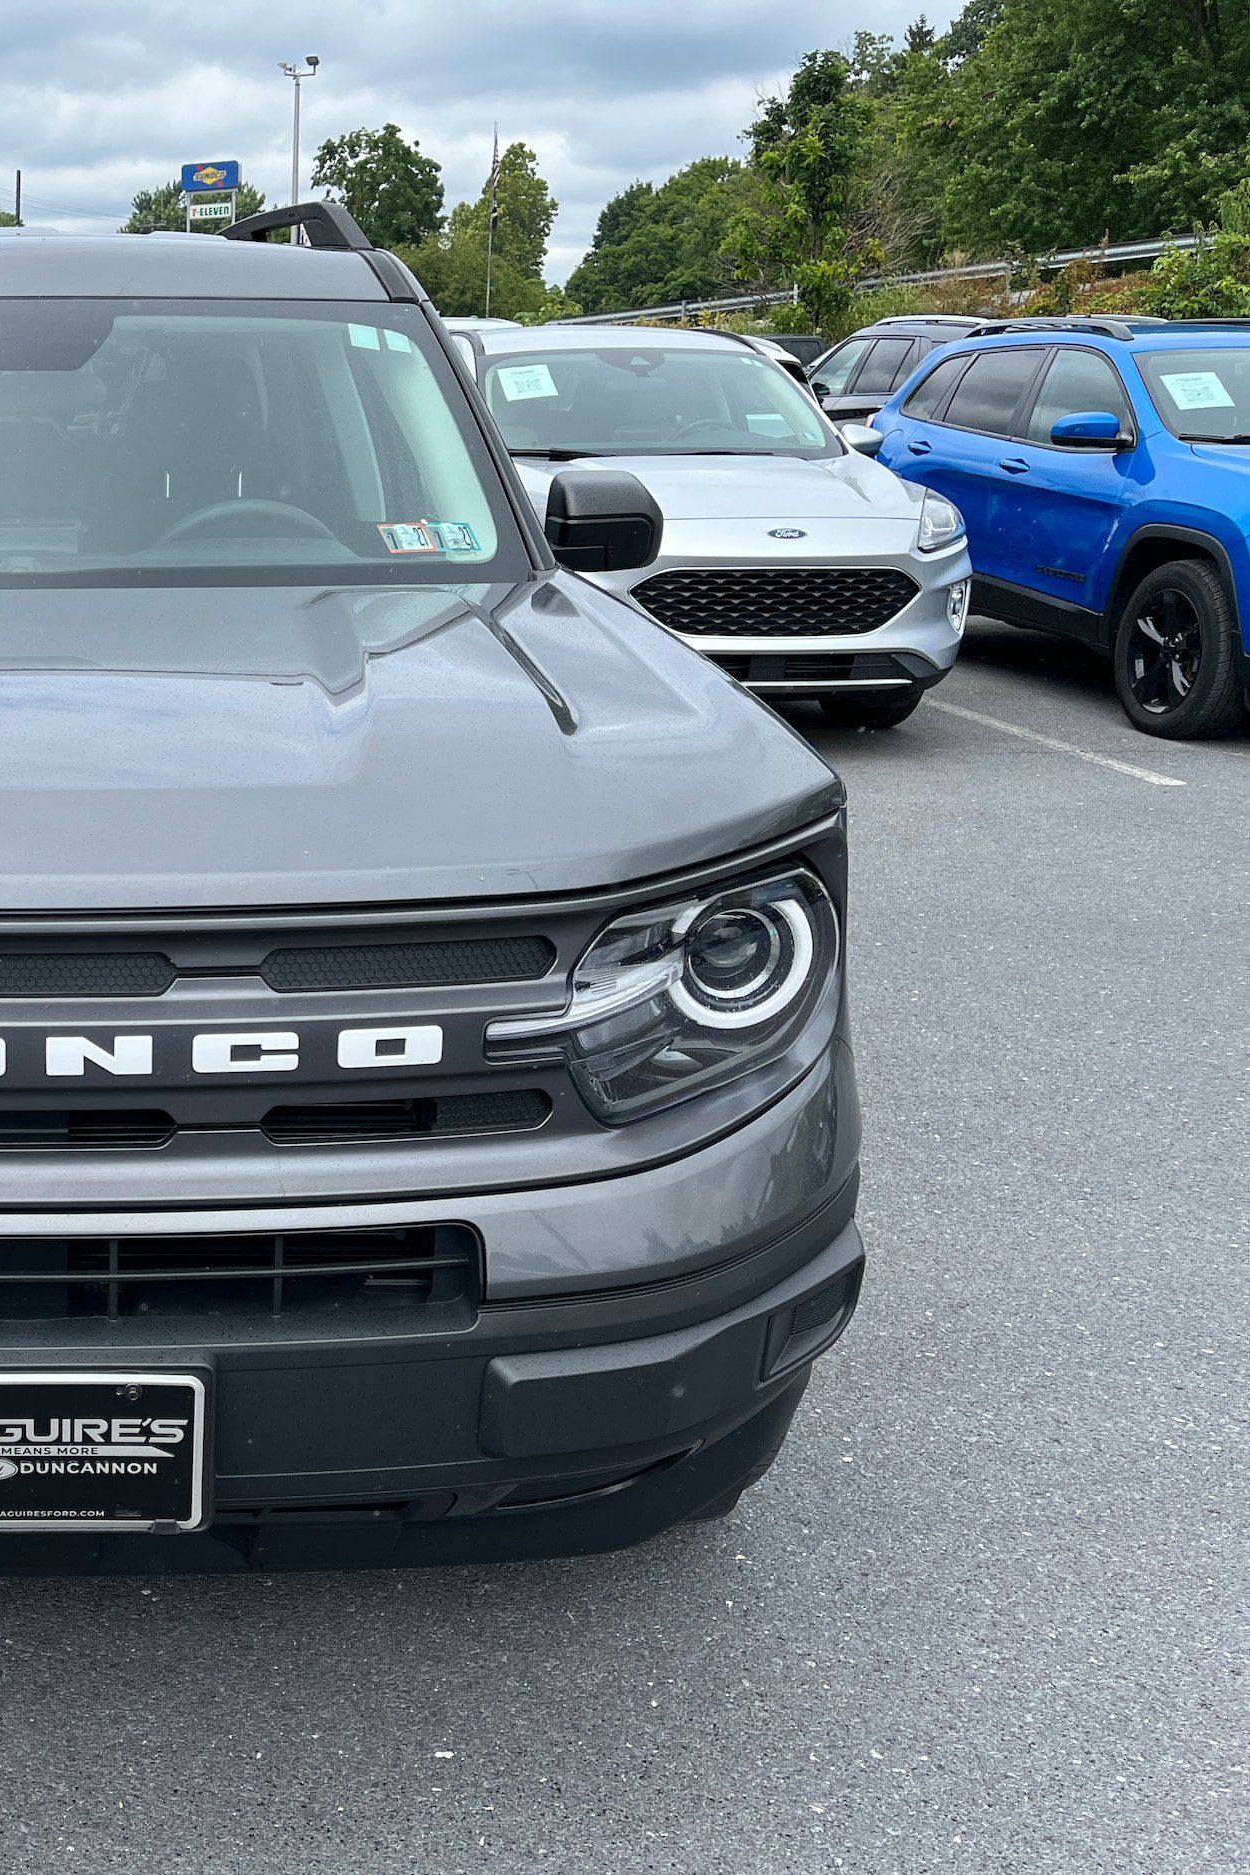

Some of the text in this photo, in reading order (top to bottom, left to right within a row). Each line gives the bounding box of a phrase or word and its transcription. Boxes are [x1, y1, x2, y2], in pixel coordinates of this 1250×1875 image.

[195, 171, 225, 180] SUNOCO
[775, 529, 800, 538] Ford
[1, 1446, 99, 1456] MEANS MORE
[20, 1462, 158, 1475] DUNCANNON
